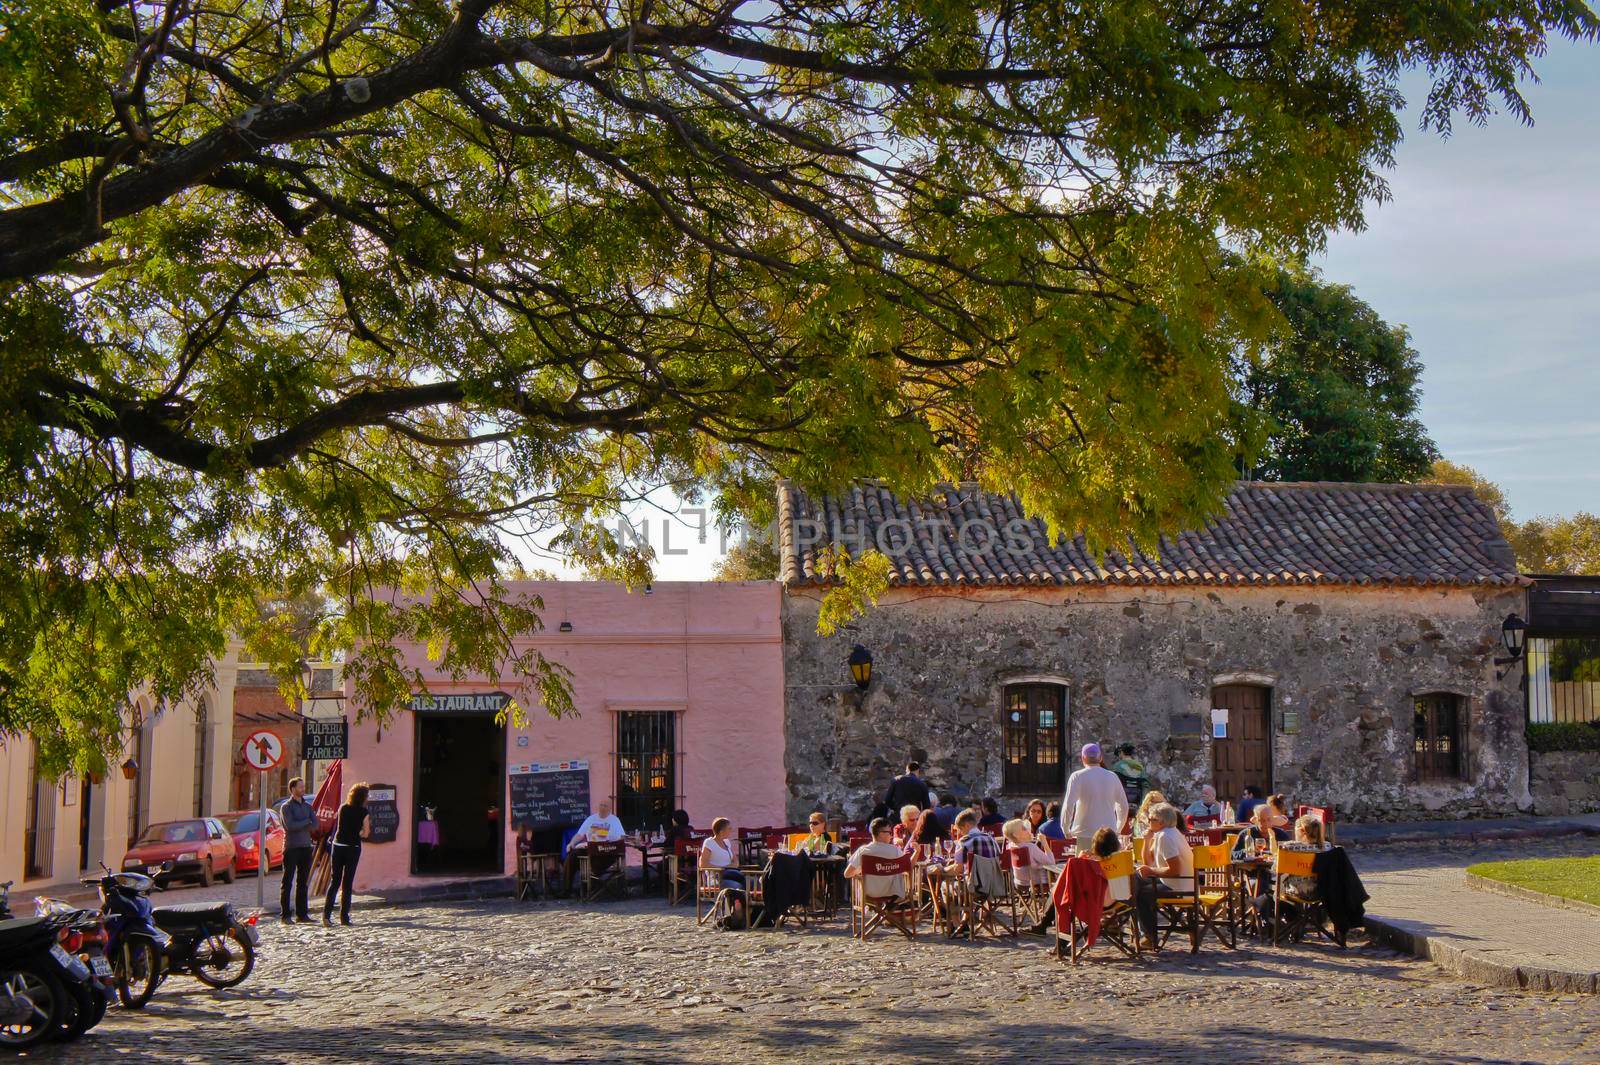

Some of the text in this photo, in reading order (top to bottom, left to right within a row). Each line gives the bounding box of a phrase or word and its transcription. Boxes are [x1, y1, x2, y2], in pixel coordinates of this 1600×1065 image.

[411, 695, 503, 711] RESTAURANT
[307, 723, 344, 735] PULPERIA
[324, 735, 342, 746] LOS
[307, 747, 345, 759] FAROLES
